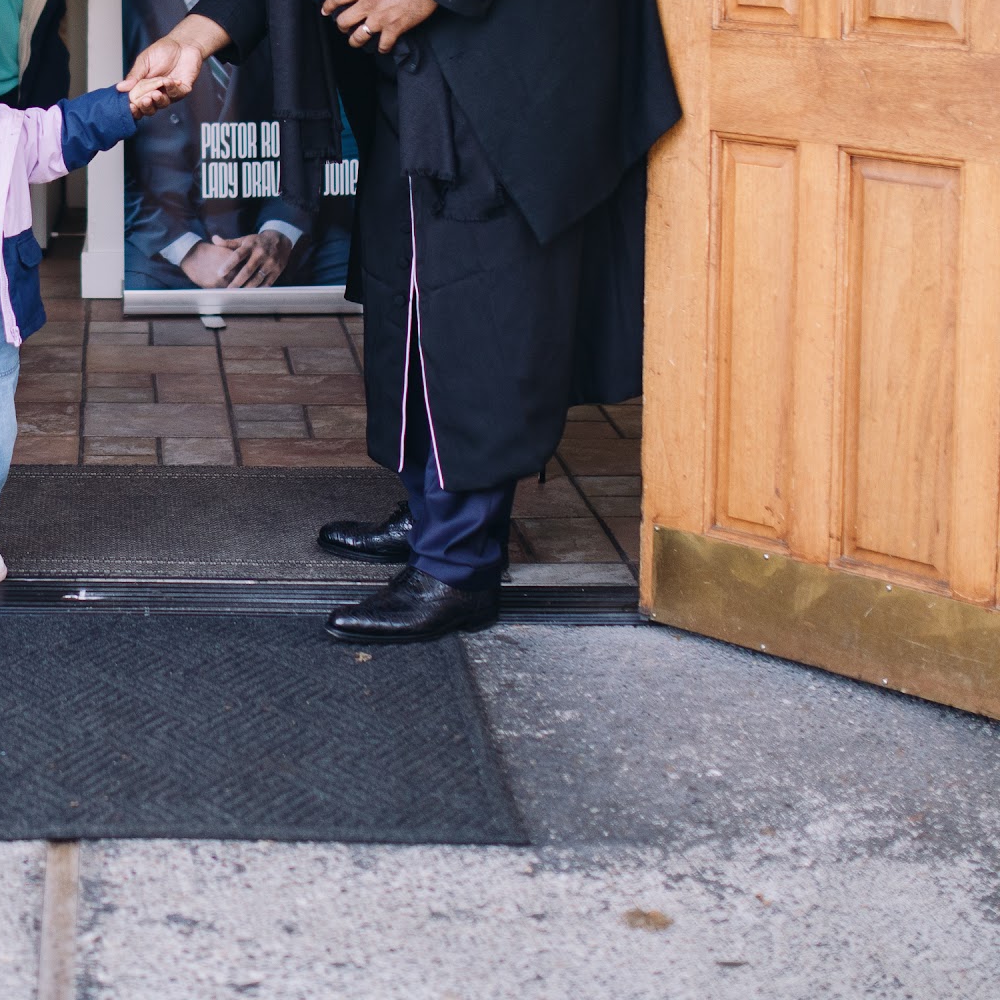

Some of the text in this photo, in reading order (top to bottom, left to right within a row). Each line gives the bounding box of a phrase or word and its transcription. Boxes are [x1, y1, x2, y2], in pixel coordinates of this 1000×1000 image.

[201, 121, 280, 159] PASTOR RO
[201, 159, 359, 199] LADY DRAV JONE
